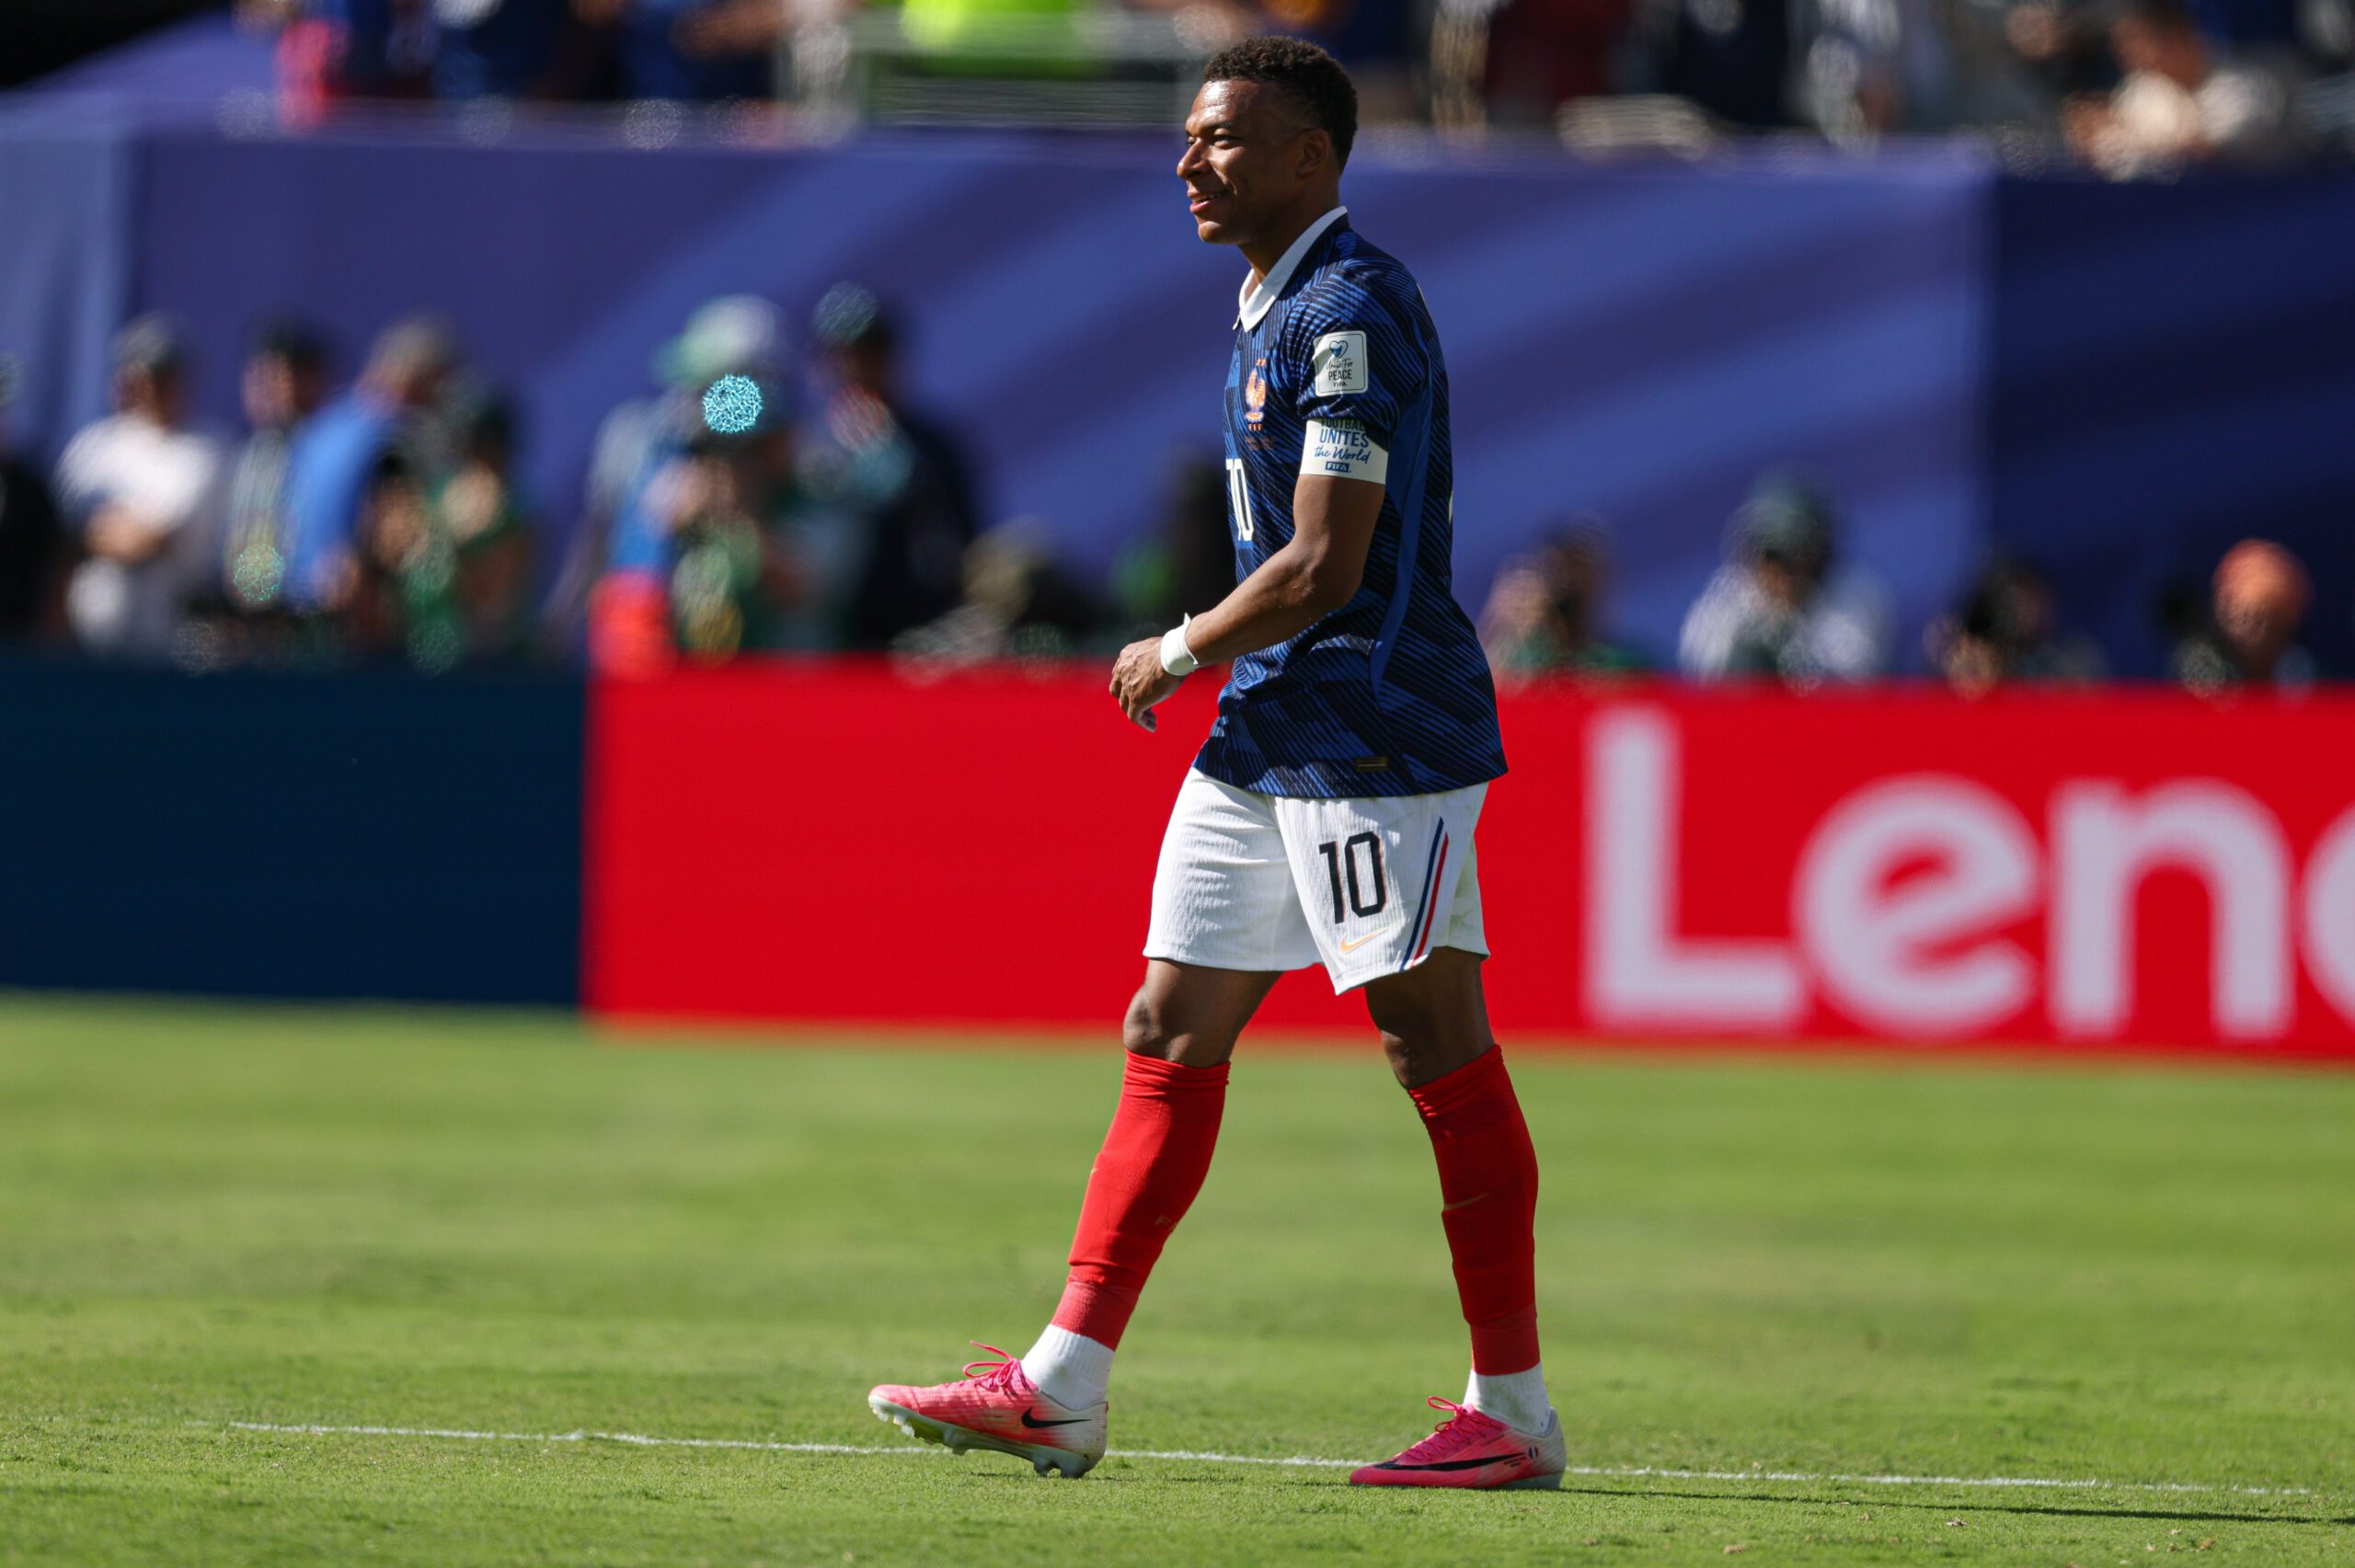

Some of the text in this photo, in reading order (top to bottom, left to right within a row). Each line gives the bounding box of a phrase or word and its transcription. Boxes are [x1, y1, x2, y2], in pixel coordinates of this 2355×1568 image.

[1327, 369, 1353, 381] PEACE
[1319, 429, 1370, 448] UNITES
[1314, 444, 1372, 464] the World
[1327, 463, 1349, 472] FIFA
[1318, 830, 1387, 925] 10
[1585, 704, 2355, 1040] Len
